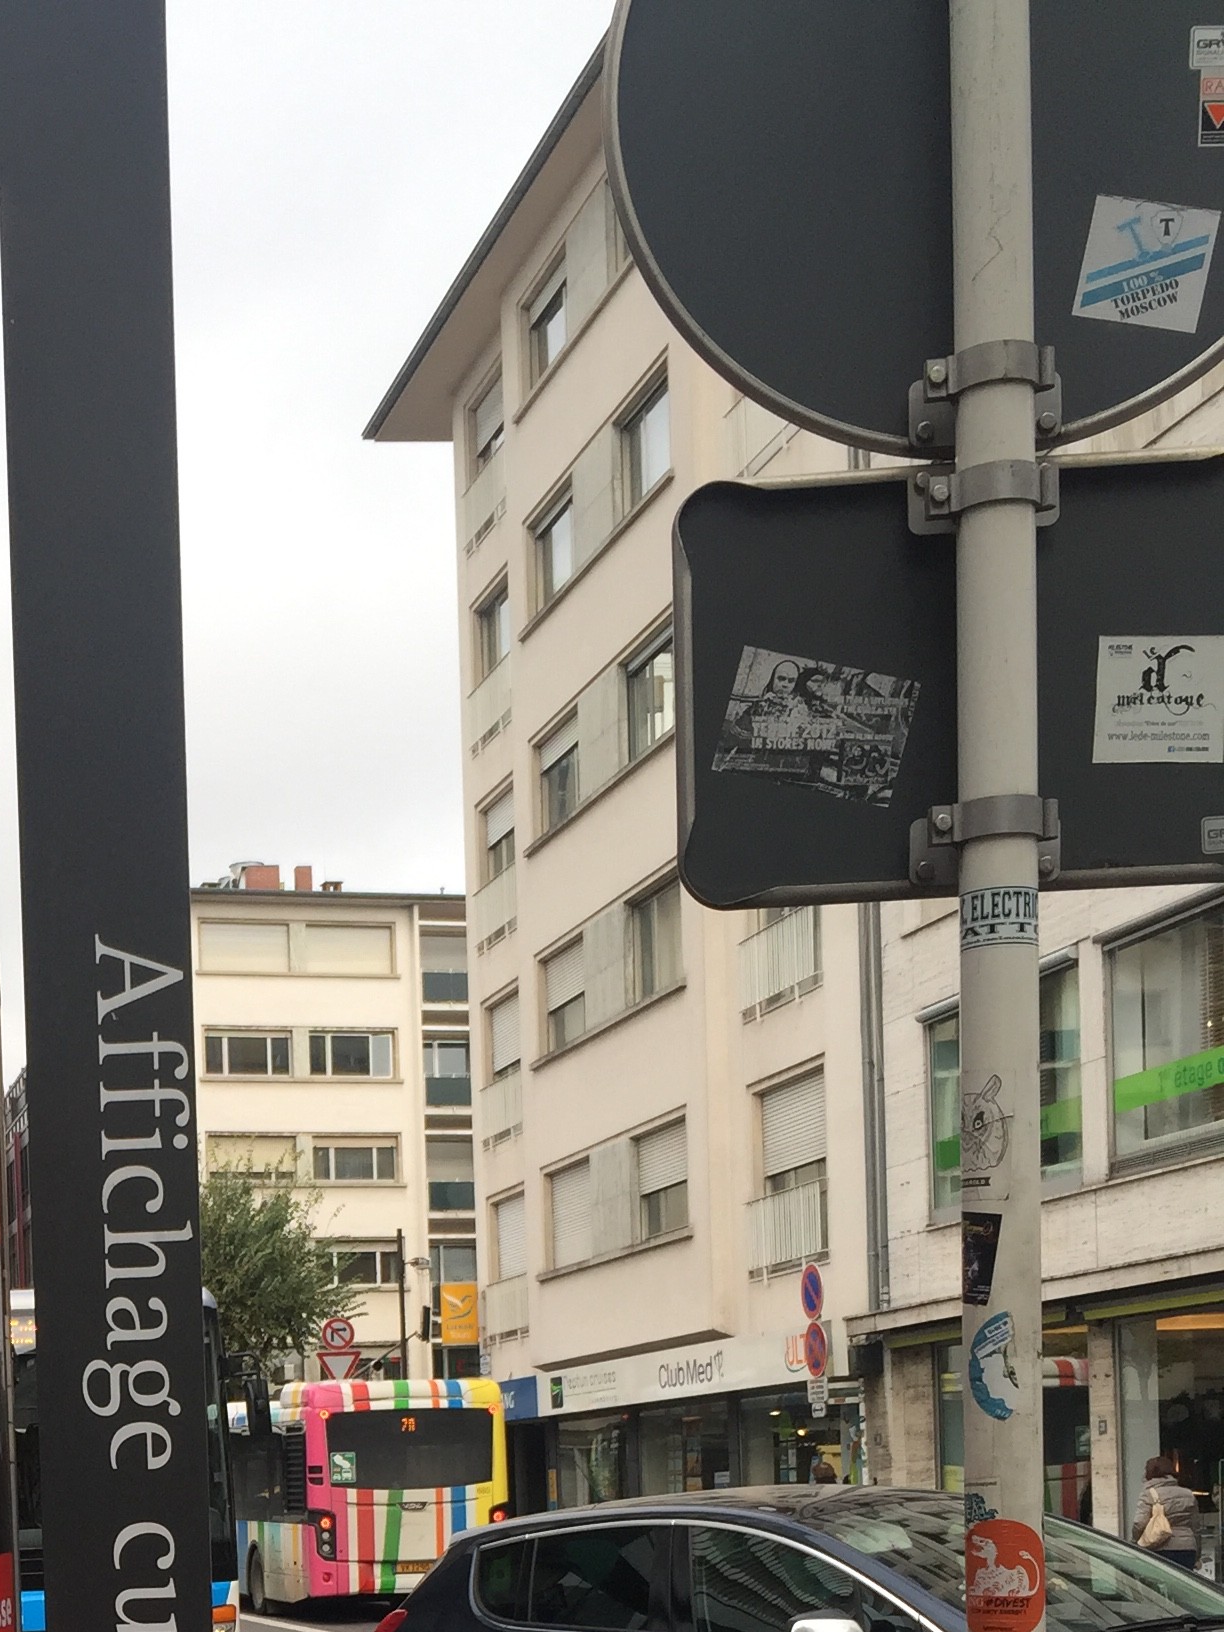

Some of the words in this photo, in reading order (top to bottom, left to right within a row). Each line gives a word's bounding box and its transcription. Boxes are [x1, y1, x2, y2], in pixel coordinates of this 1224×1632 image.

[1111, 279, 1179, 309] TORPEDO
[1119, 292, 1179, 321] MOSCOW
[83, 933, 193, 1470] Affichage
